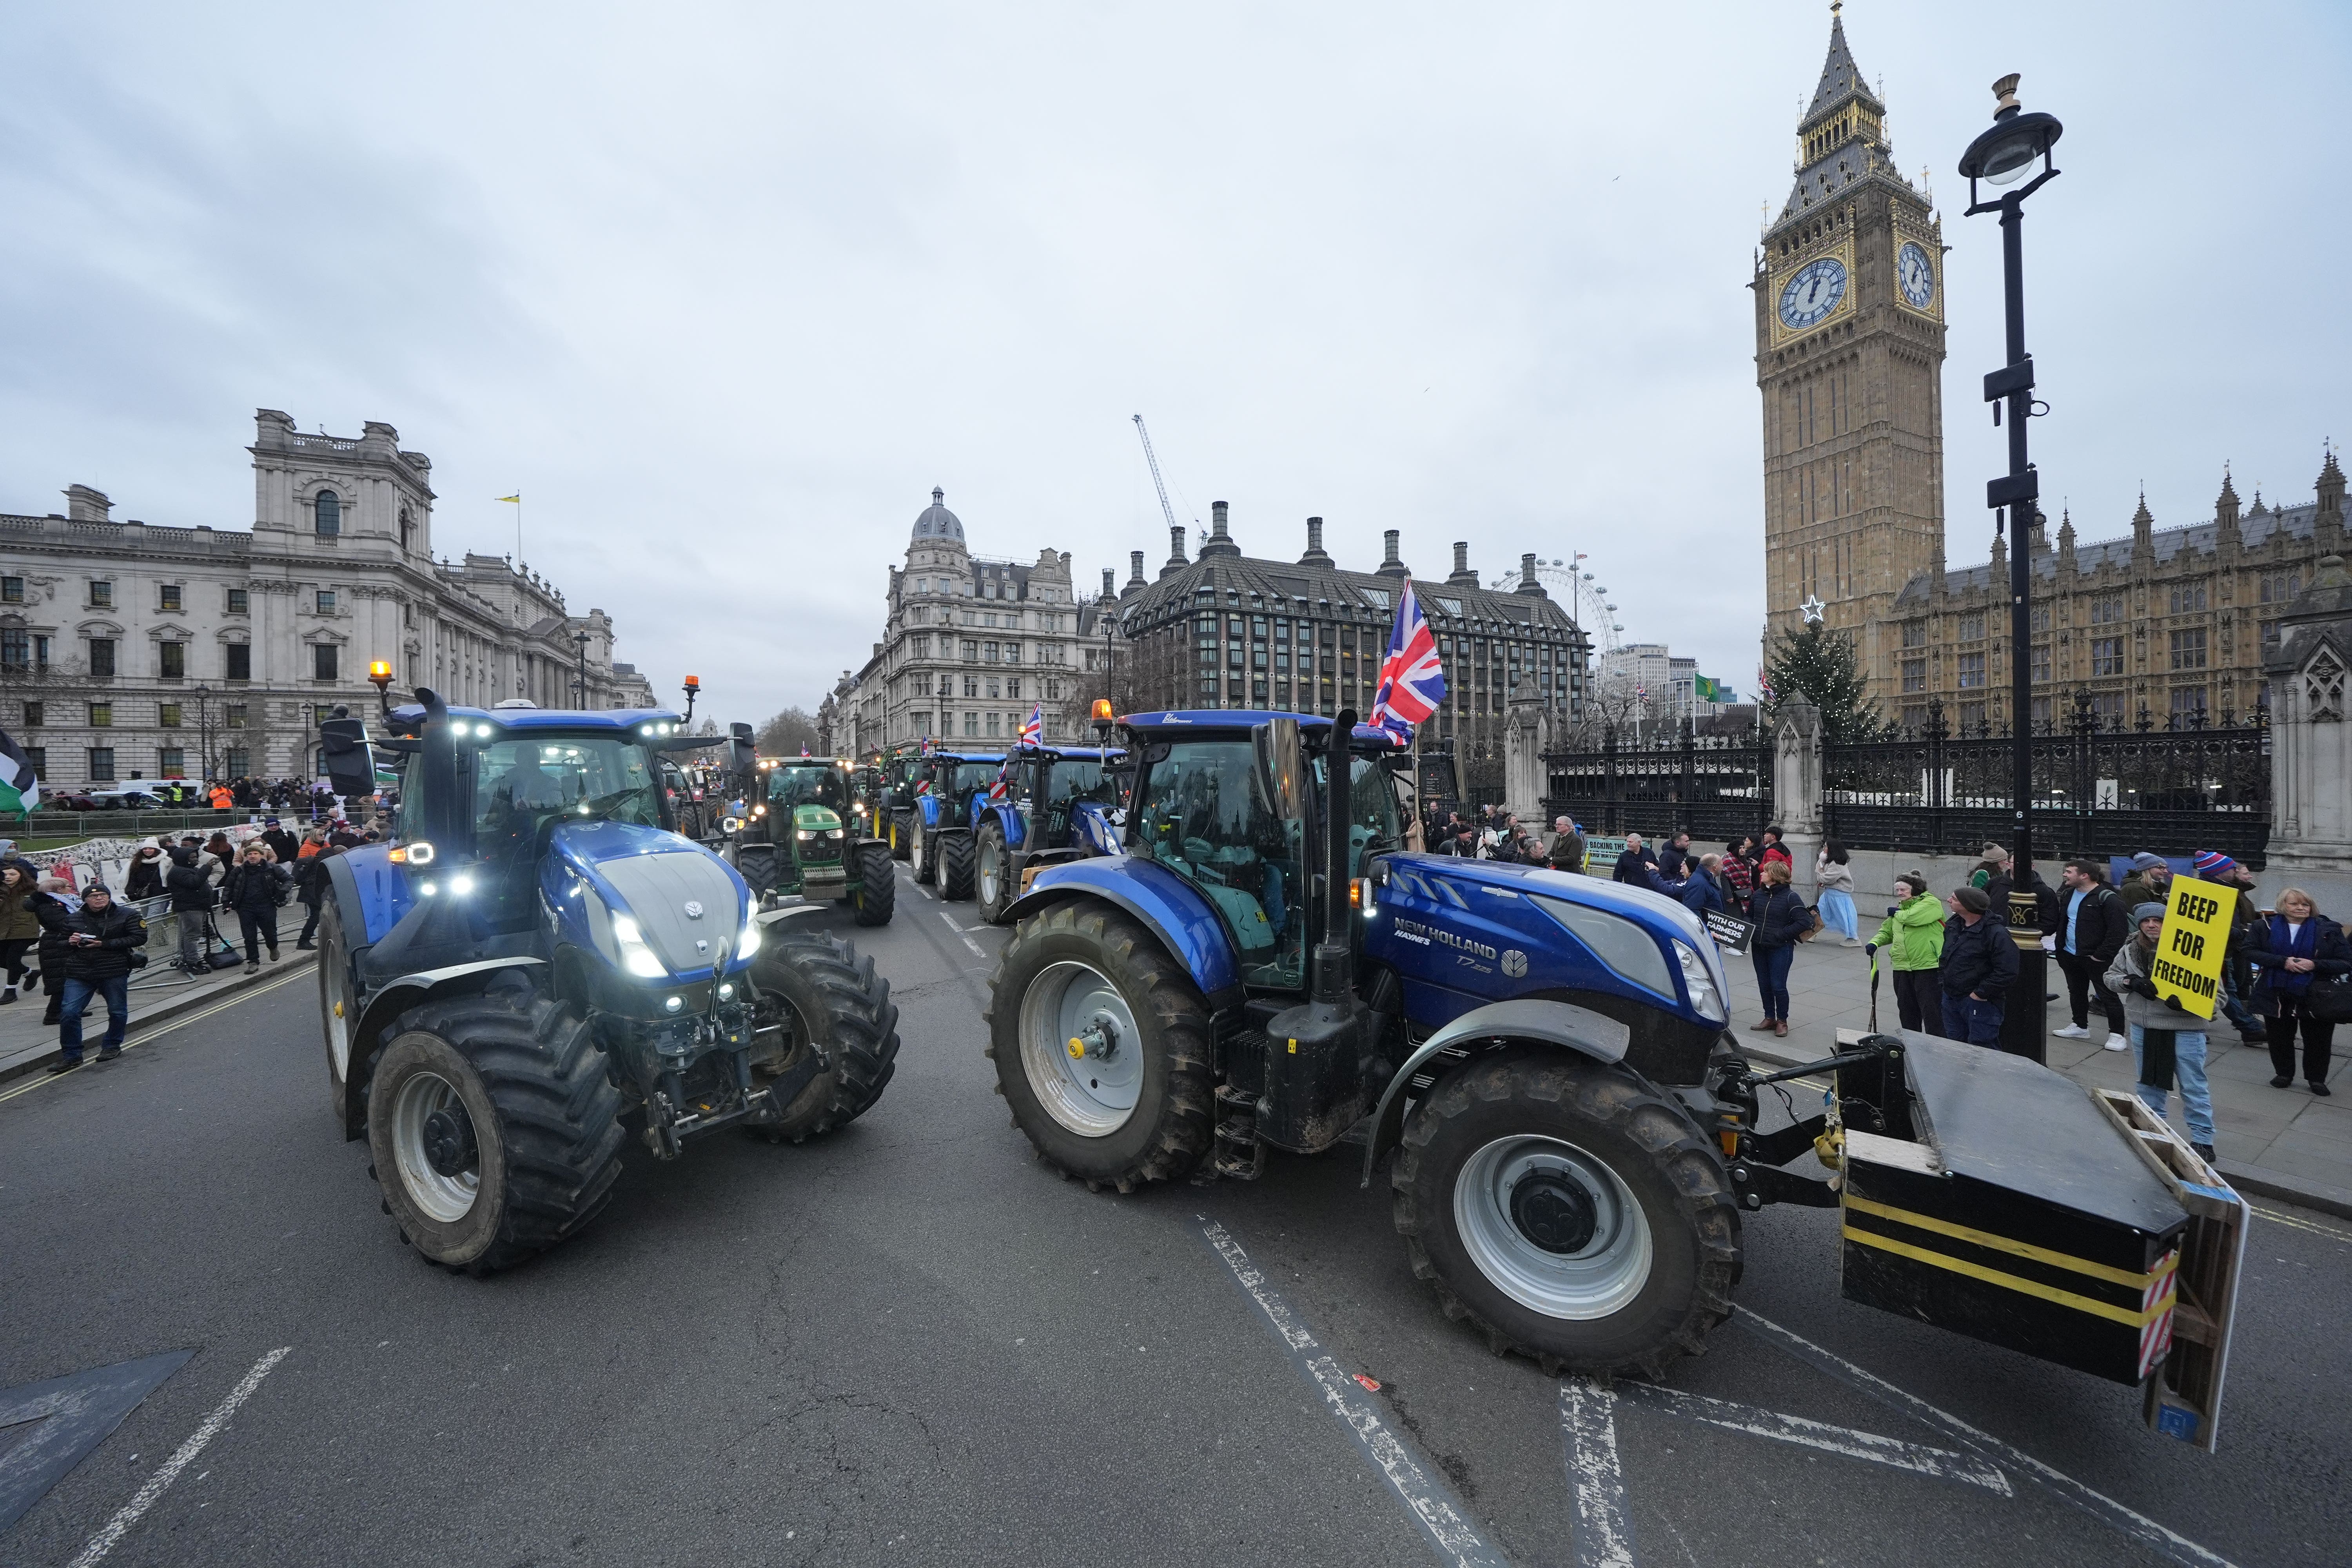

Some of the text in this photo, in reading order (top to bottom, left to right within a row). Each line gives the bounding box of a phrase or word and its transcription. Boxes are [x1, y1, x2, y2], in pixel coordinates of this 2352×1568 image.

[1590, 841, 1613, 850] BACKING
[2176, 892, 2218, 924] BEEP
[1707, 921, 1742, 938] FARMERS
[1708, 913, 1745, 931] WITH OUR
[1394, 929, 1431, 946] HAYNES
[1395, 917, 1497, 960] NEW HOLLAND
[2172, 928, 2205, 961] FOR
[2154, 958, 2216, 1000] FREEDOM
